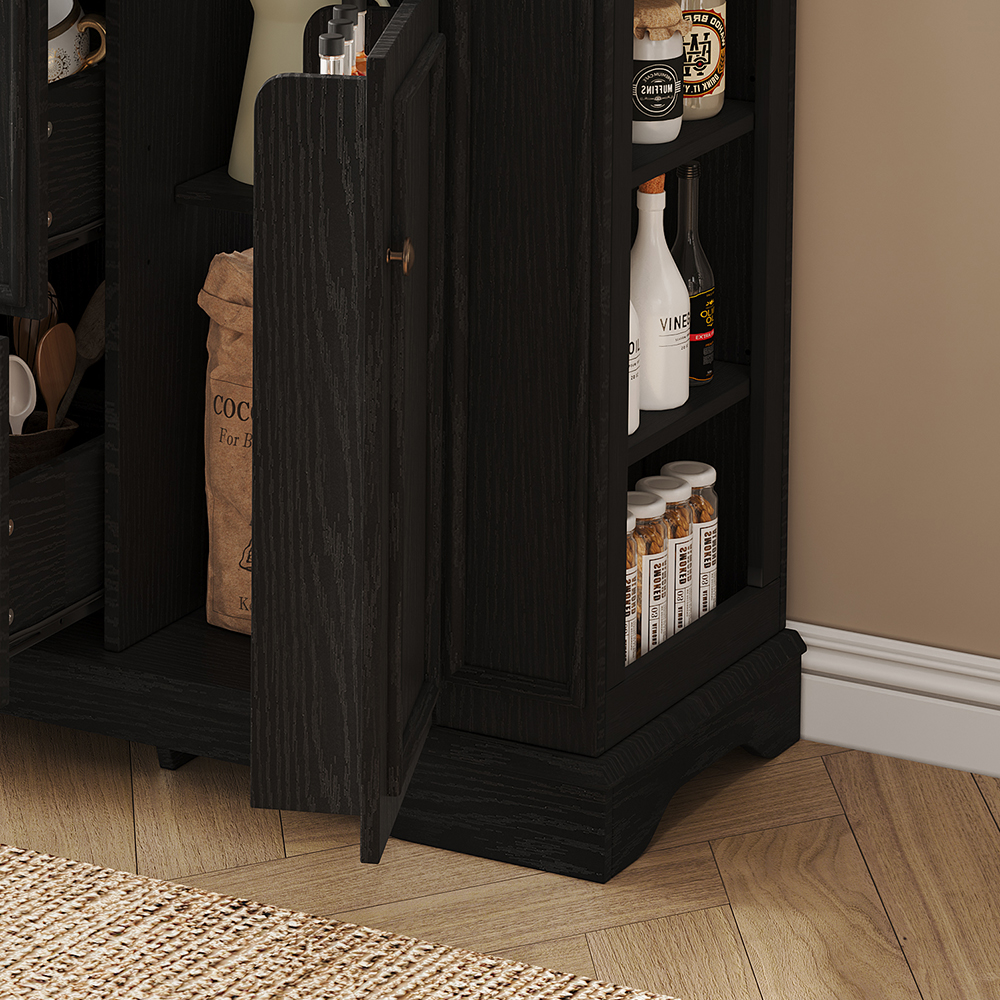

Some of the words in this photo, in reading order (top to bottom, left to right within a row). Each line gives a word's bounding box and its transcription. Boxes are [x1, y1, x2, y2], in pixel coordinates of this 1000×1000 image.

[629, 338, 640, 354] OIL
[213, 395, 252, 421] COC
[219, 427, 239, 446] For
